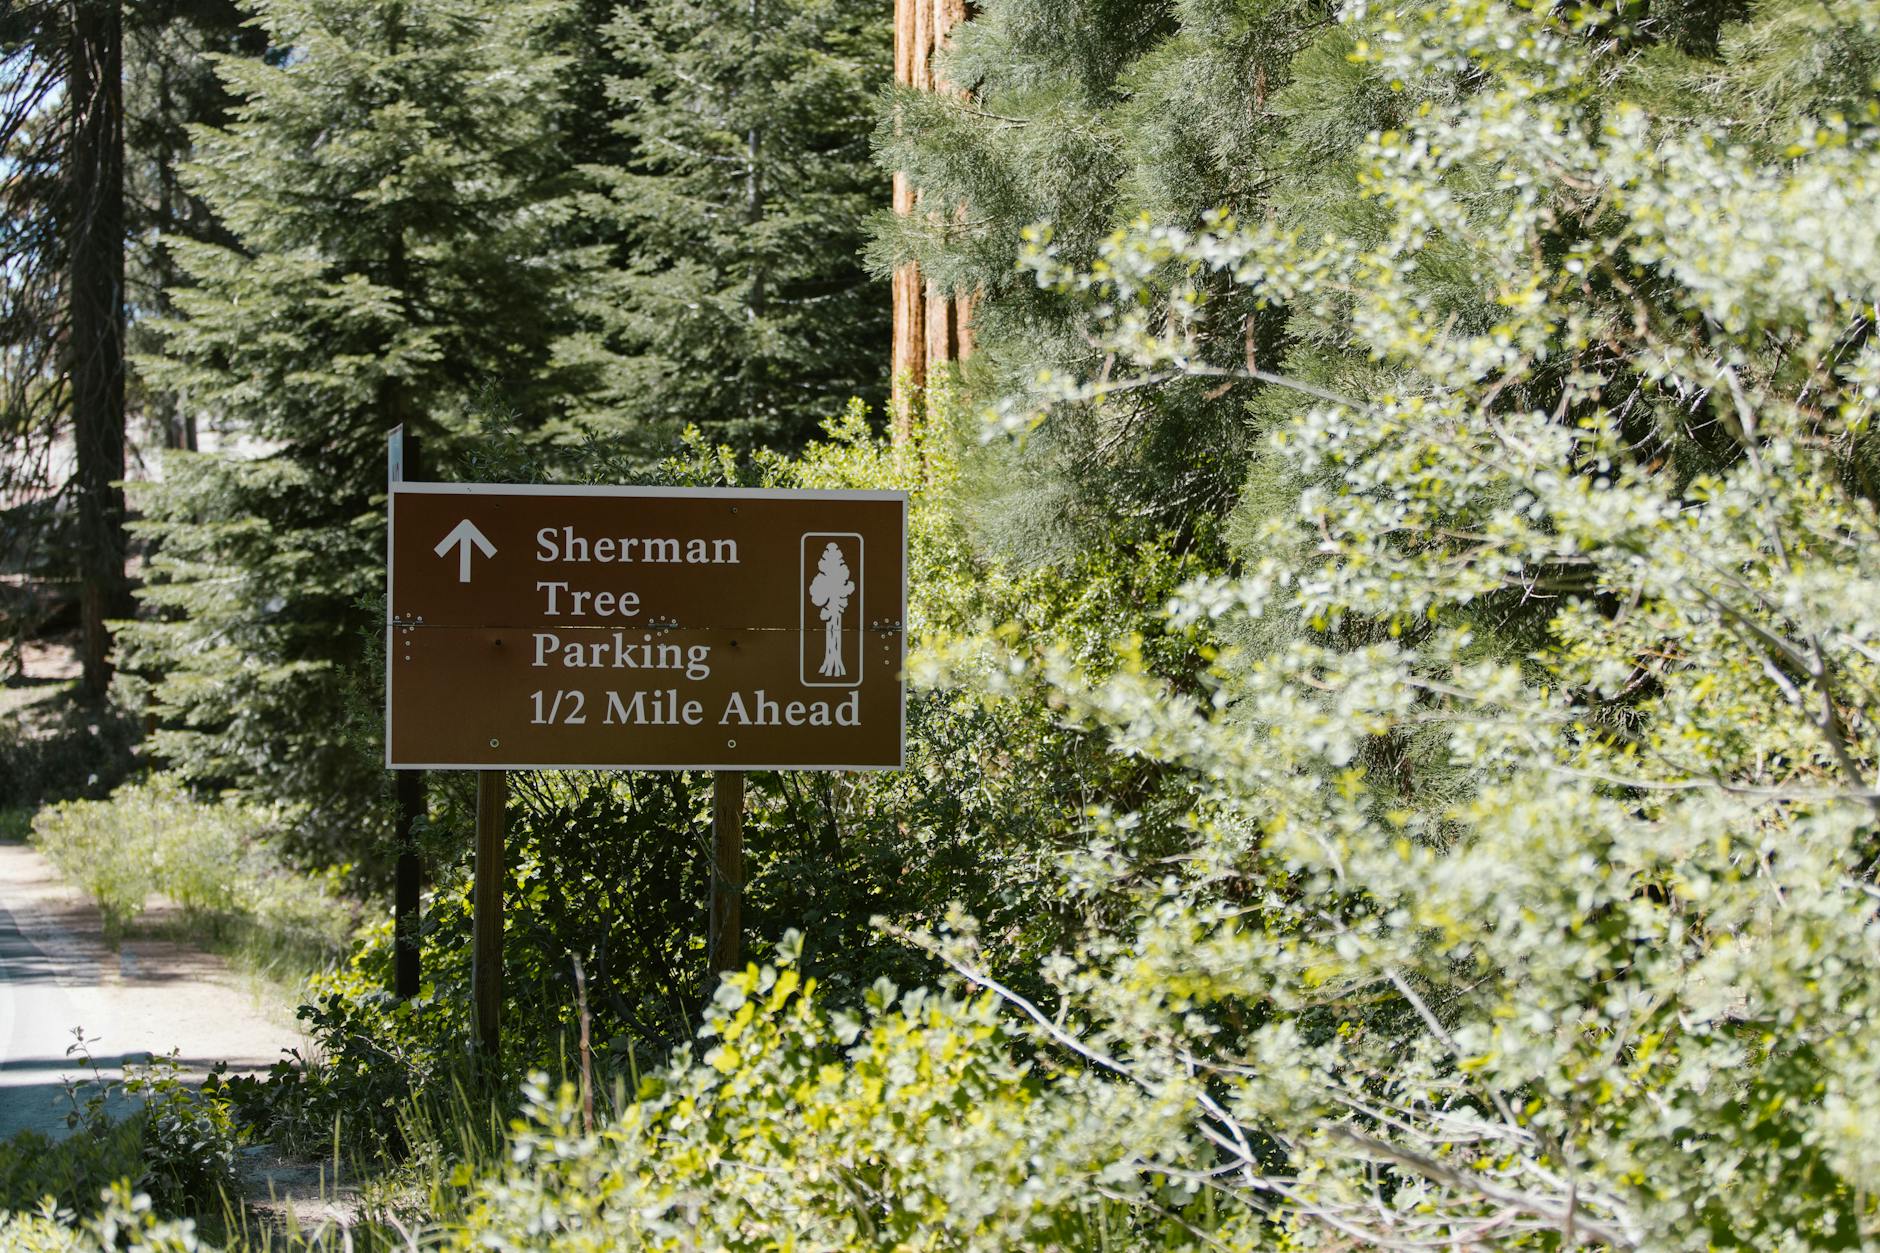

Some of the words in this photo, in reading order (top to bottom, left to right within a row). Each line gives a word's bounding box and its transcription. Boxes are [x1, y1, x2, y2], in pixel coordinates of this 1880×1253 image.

[536, 526, 740, 564] Sherman
[536, 581, 640, 616] Tree
[532, 632, 711, 681] Parking
[530, 690, 587, 725] 1/2
[602, 689, 704, 725] Mile
[718, 689, 861, 726] Ahead
